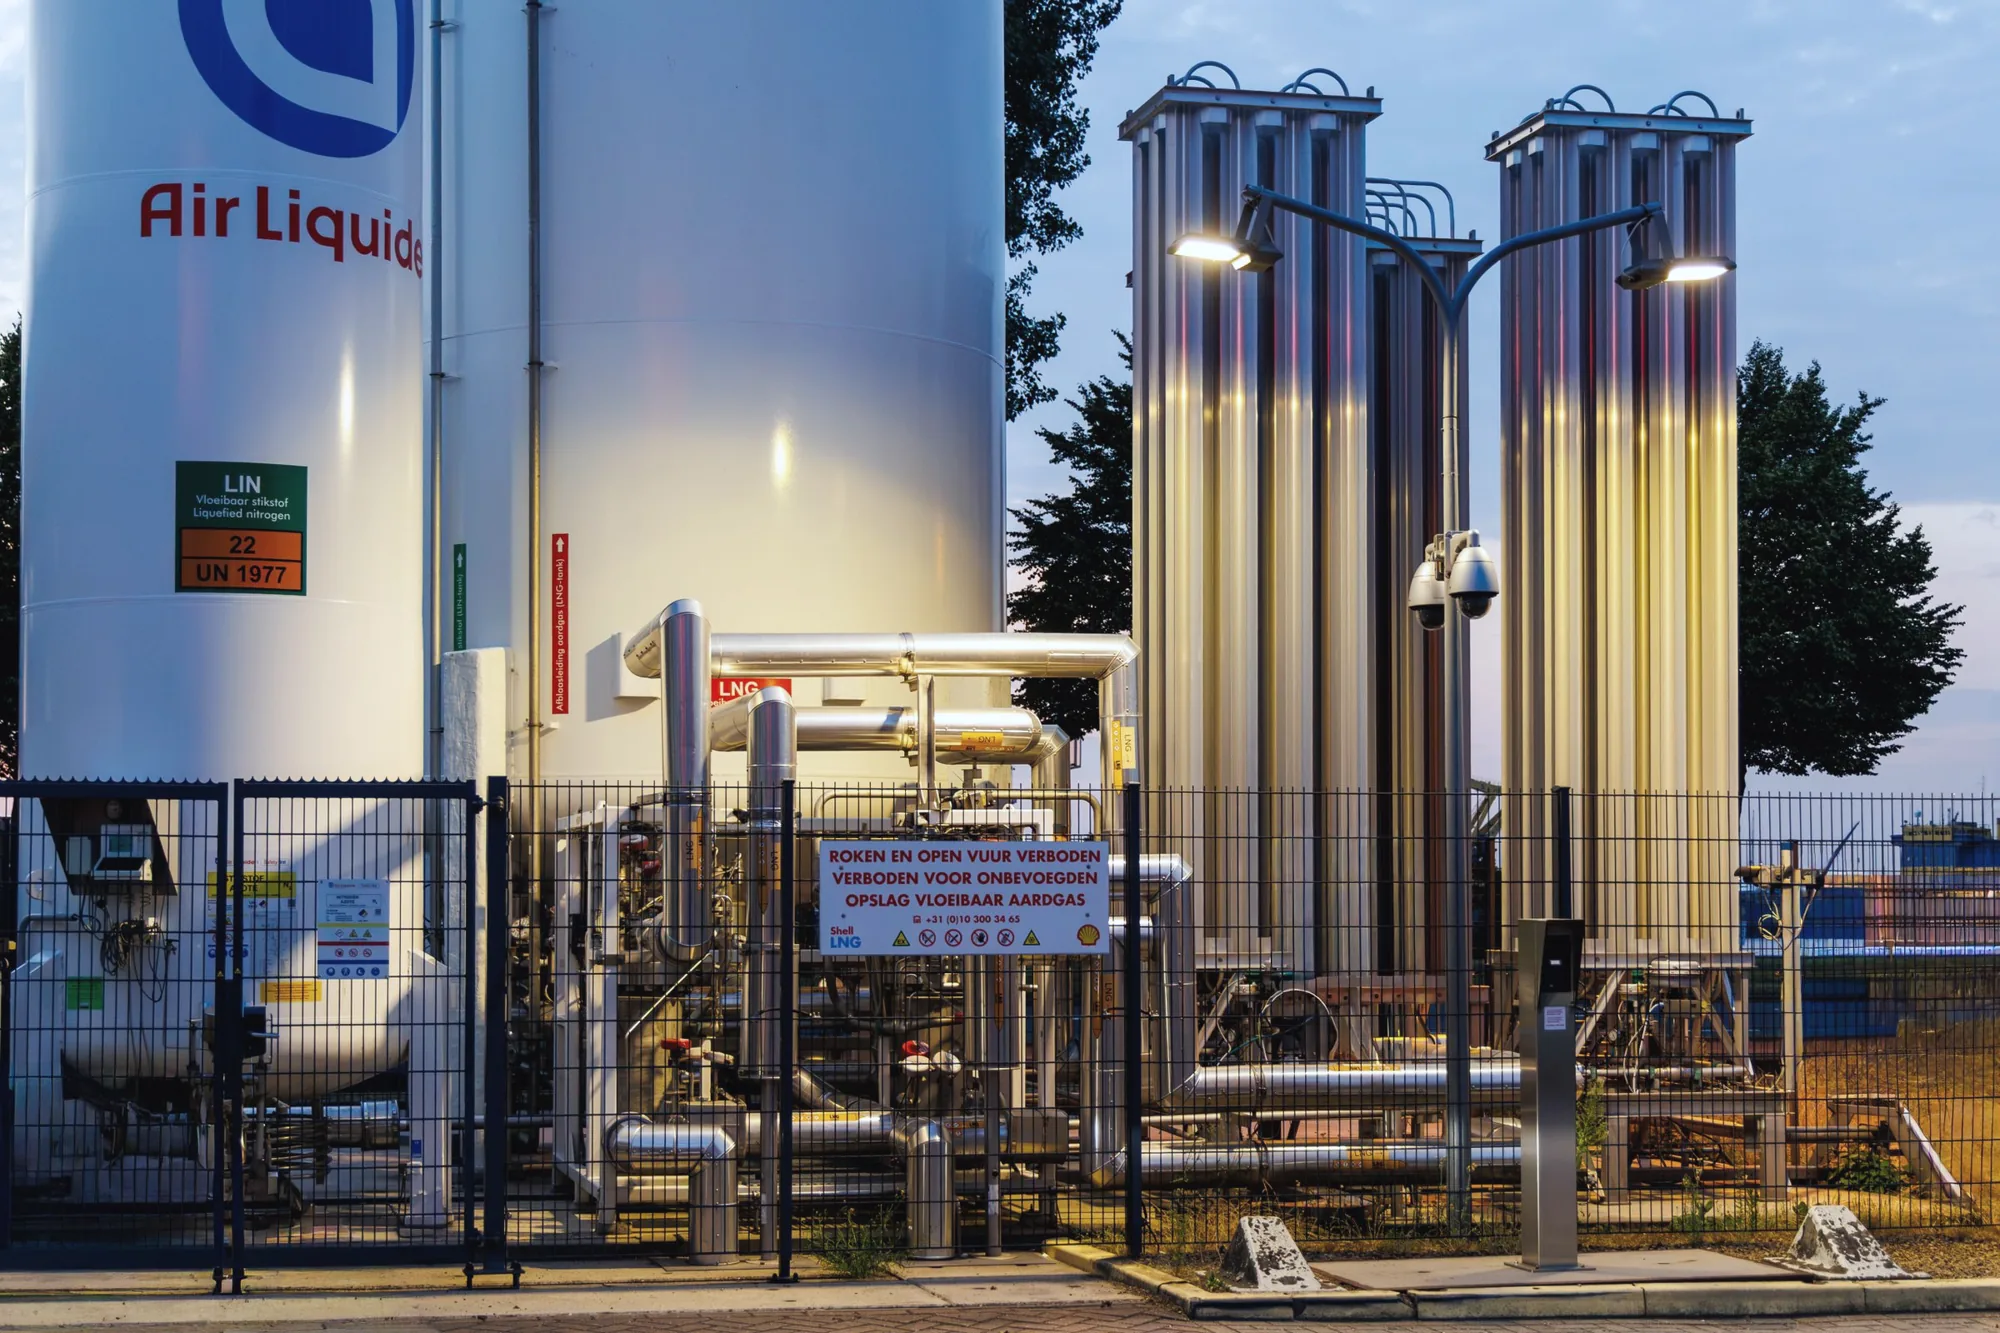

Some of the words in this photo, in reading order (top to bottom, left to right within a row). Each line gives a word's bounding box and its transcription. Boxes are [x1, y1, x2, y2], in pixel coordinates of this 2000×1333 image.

[140, 183, 240, 237] Air
[256, 186, 423, 279] Liquide
[225, 475, 261, 493] LIN
[196, 495, 248, 506] Vloeibaar
[252, 497, 289, 508] stikstof
[193, 508, 243, 519] Liquefied
[246, 509, 291, 522] nitrogen
[229, 536, 256, 554] 22
[196, 564, 228, 582] UN
[237, 565, 286, 583] 1977
[556, 559, 565, 607] (LNG-tank)
[556, 610, 565, 646] aardgas
[556, 648, 565, 712] Afblaasleiding
[720, 681, 760, 697] LNG
[686, 840, 694, 861] LNG
[829, 850, 886, 862] ROKEN
[891, 850, 912, 862] EN
[917, 850, 962, 862] OPEN
[967, 850, 1011, 862] VUUR
[1016, 850, 1101, 862] VERBODEN
[832, 872, 918, 885] VERBODEN
[923, 872, 972, 885] VOOR
[977, 872, 1098, 885] ONBEVOEGDEN
[229, 884, 259, 892] AOTE
[845, 893, 910, 907] OPSLAG
[915, 893, 1003, 907] VLOEIBAAR
[1009, 893, 1086, 907] AARDGAS
[925, 915, 943, 923] +31
[946, 914, 971, 925] (0)10
[973, 915, 991, 923] 300
[994, 915, 1006, 923] 34
[1008, 915, 1020, 923] 65
[830, 926, 854, 935] Shell
[830, 936, 862, 948] LNG
[1105, 983, 1113, 1002] LNG
